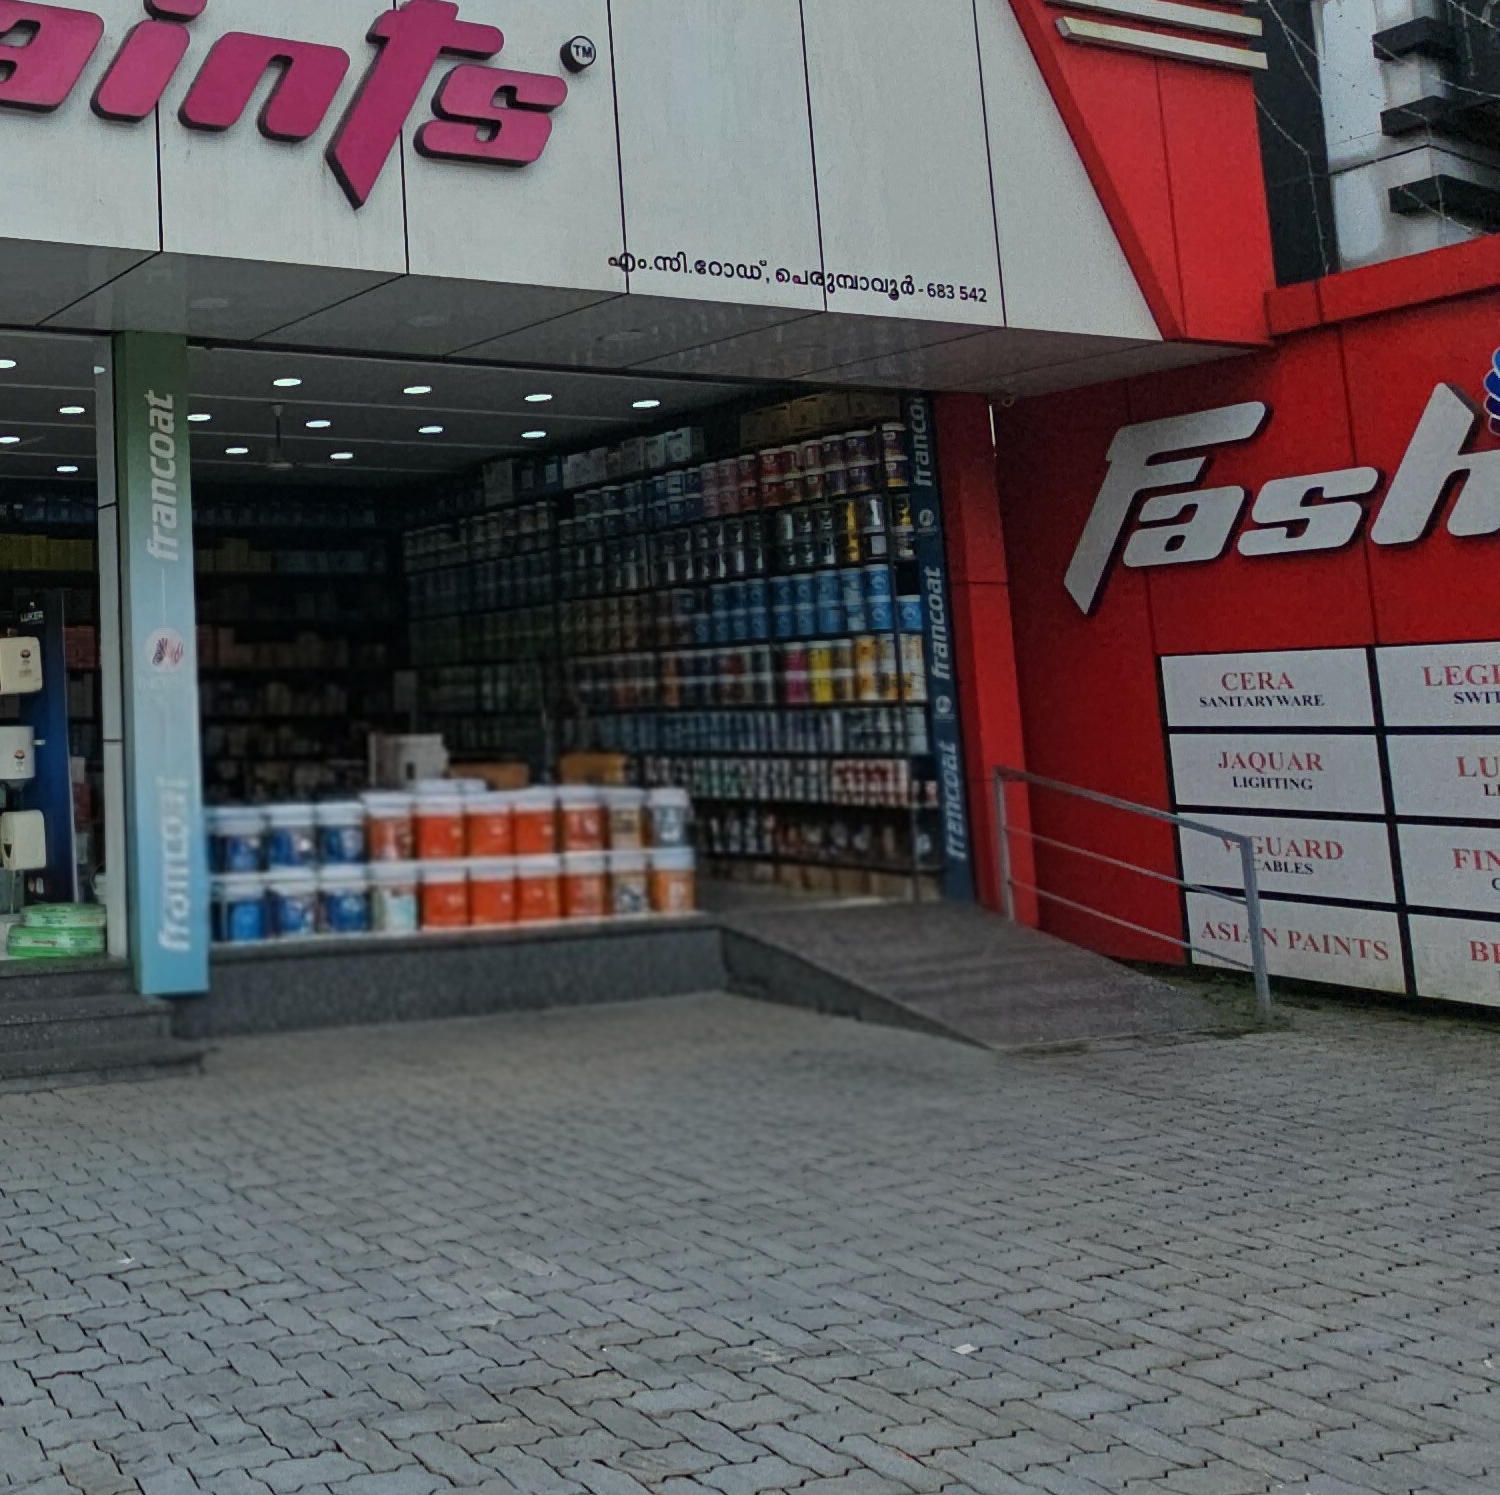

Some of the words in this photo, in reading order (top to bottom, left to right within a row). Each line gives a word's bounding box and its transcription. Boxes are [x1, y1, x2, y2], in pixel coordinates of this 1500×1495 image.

[959, 286, 987, 303] 542
[910, 397, 932, 487] franco
[144, 389, 179, 561] francoat
[1063, 382, 1500, 615] Fash
[924, 565, 950, 680] francoat
[1221, 671, 1295, 691] CERA
[1199, 694, 1325, 708] SANITARYWARE
[1218, 751, 1323, 774] JAQUAR
[1232, 776, 1313, 791] LIGHTING
[938, 740, 967, 860] francoat
[1288, 930, 1389, 961] PAINTS
